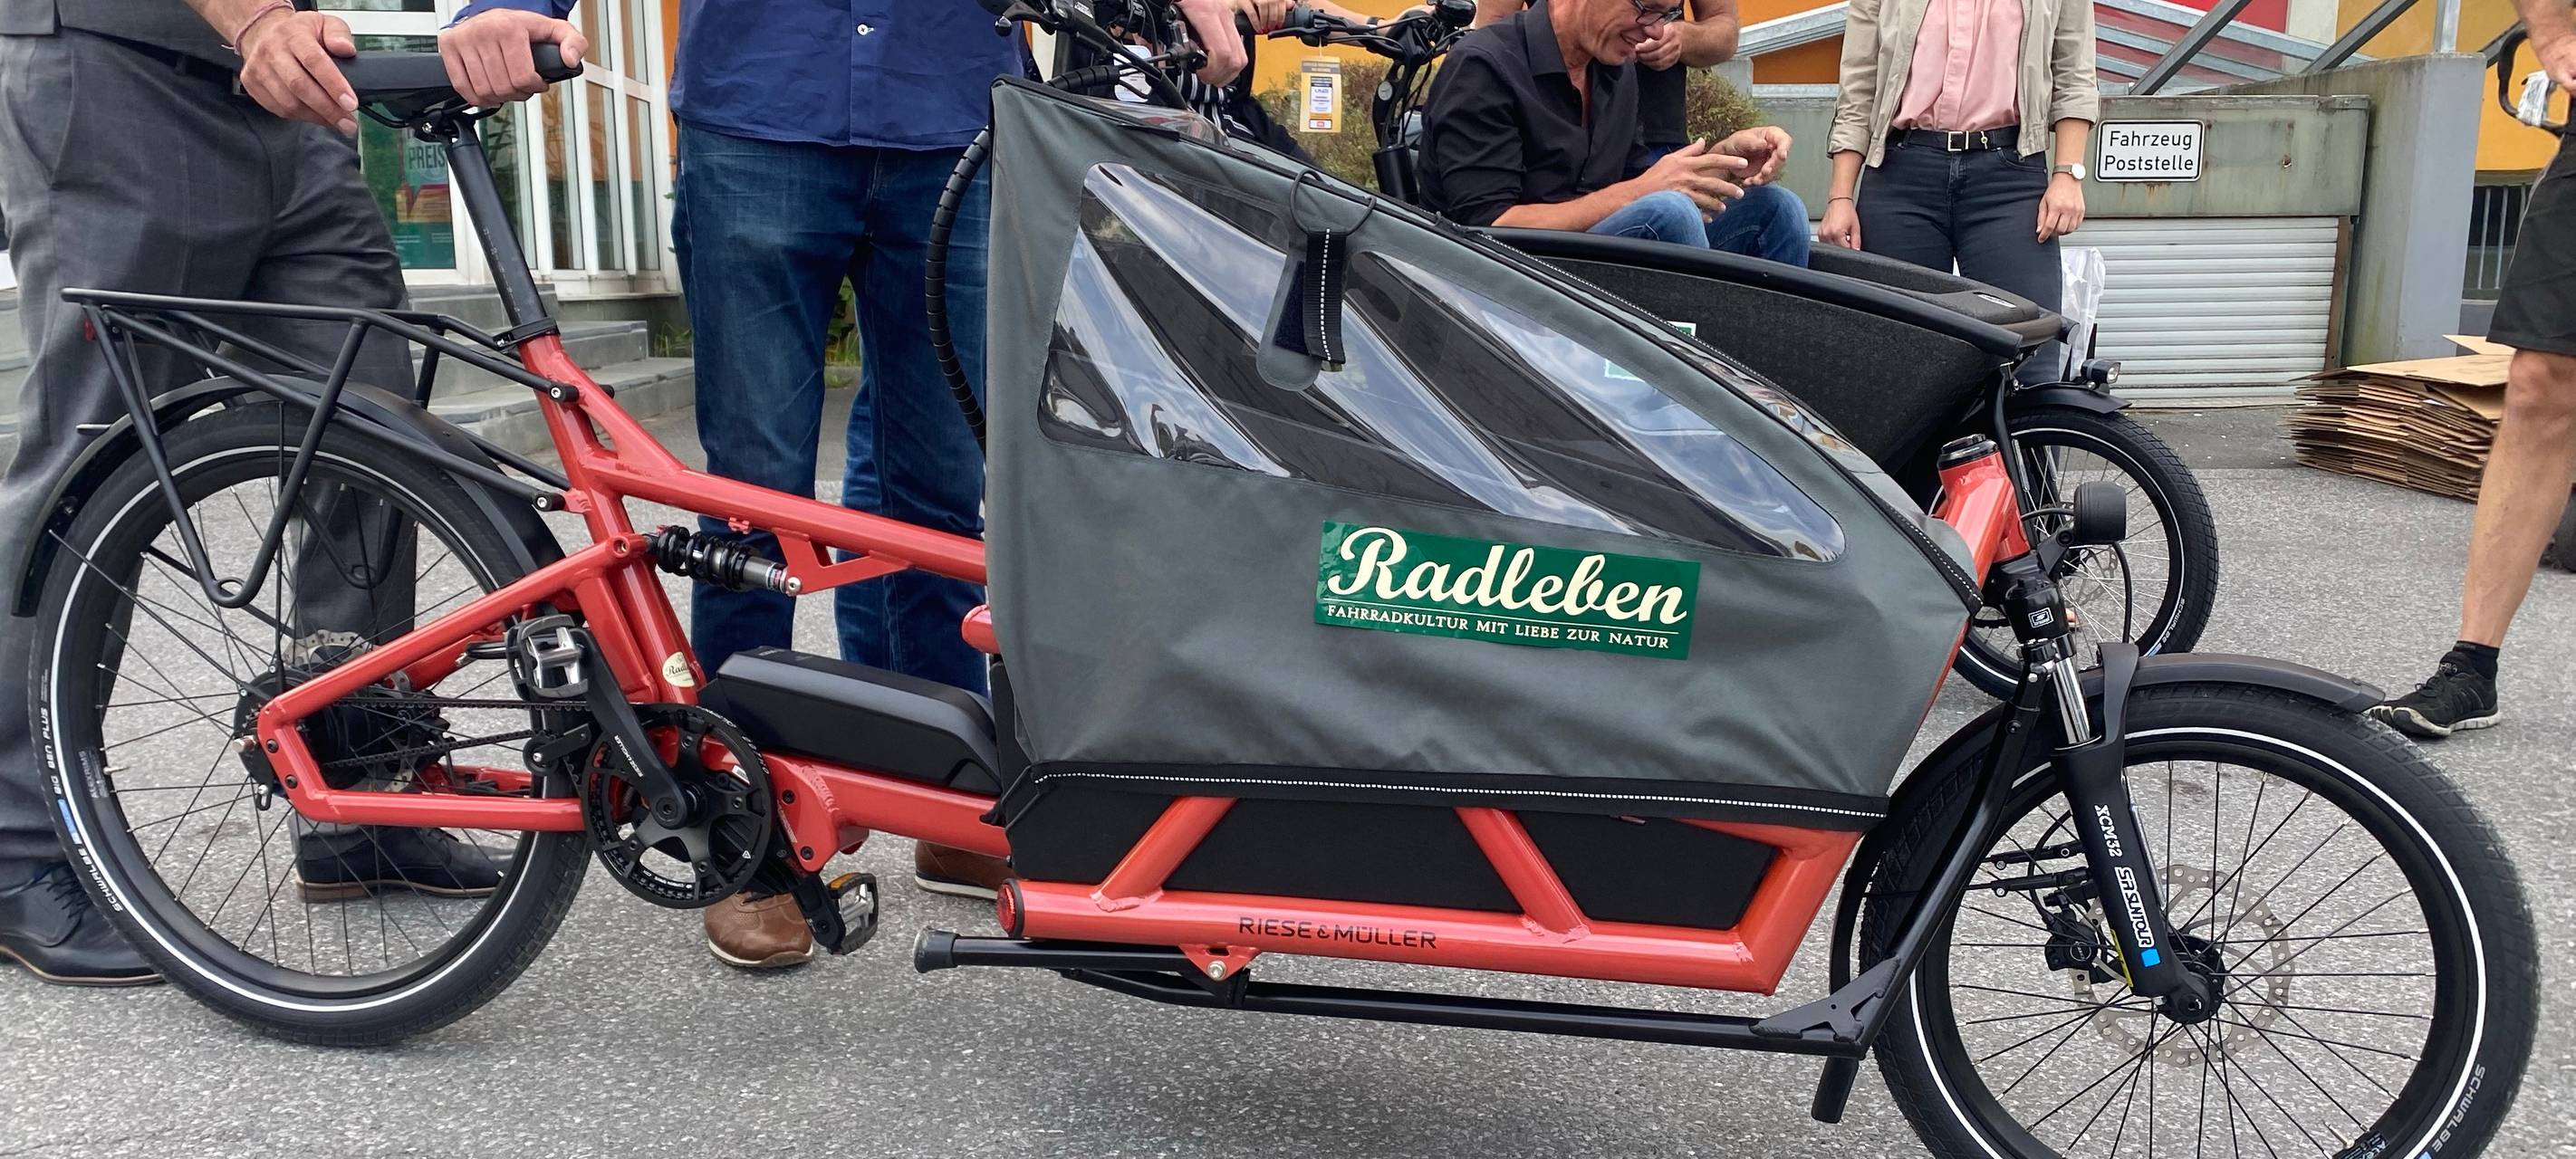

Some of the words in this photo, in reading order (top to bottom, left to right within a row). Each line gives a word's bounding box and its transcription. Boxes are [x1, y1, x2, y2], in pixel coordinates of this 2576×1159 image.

[409, 145, 446, 168] PREIS
[2110, 130, 2192, 150] Fahrzeug
[2104, 155, 2194, 171] Poststelle
[1327, 527, 1687, 625] Radleben
[1327, 606, 1469, 630] FAHRRADKULTUR
[1475, 619, 1509, 635] MIT
[1514, 624, 1560, 639] LIEBE
[1566, 628, 1600, 643] ZUR
[1608, 632, 1669, 648] NATUR
[41, 707, 51, 740] PLUS
[50, 775, 62, 795] BIG
[2094, 805, 2123, 857] XCM32
[78, 848, 123, 912] SCHWALBE
[2125, 891, 2154, 947] SUNTOUR
[2432, 1064, 2485, 1153] SCHWALBE
